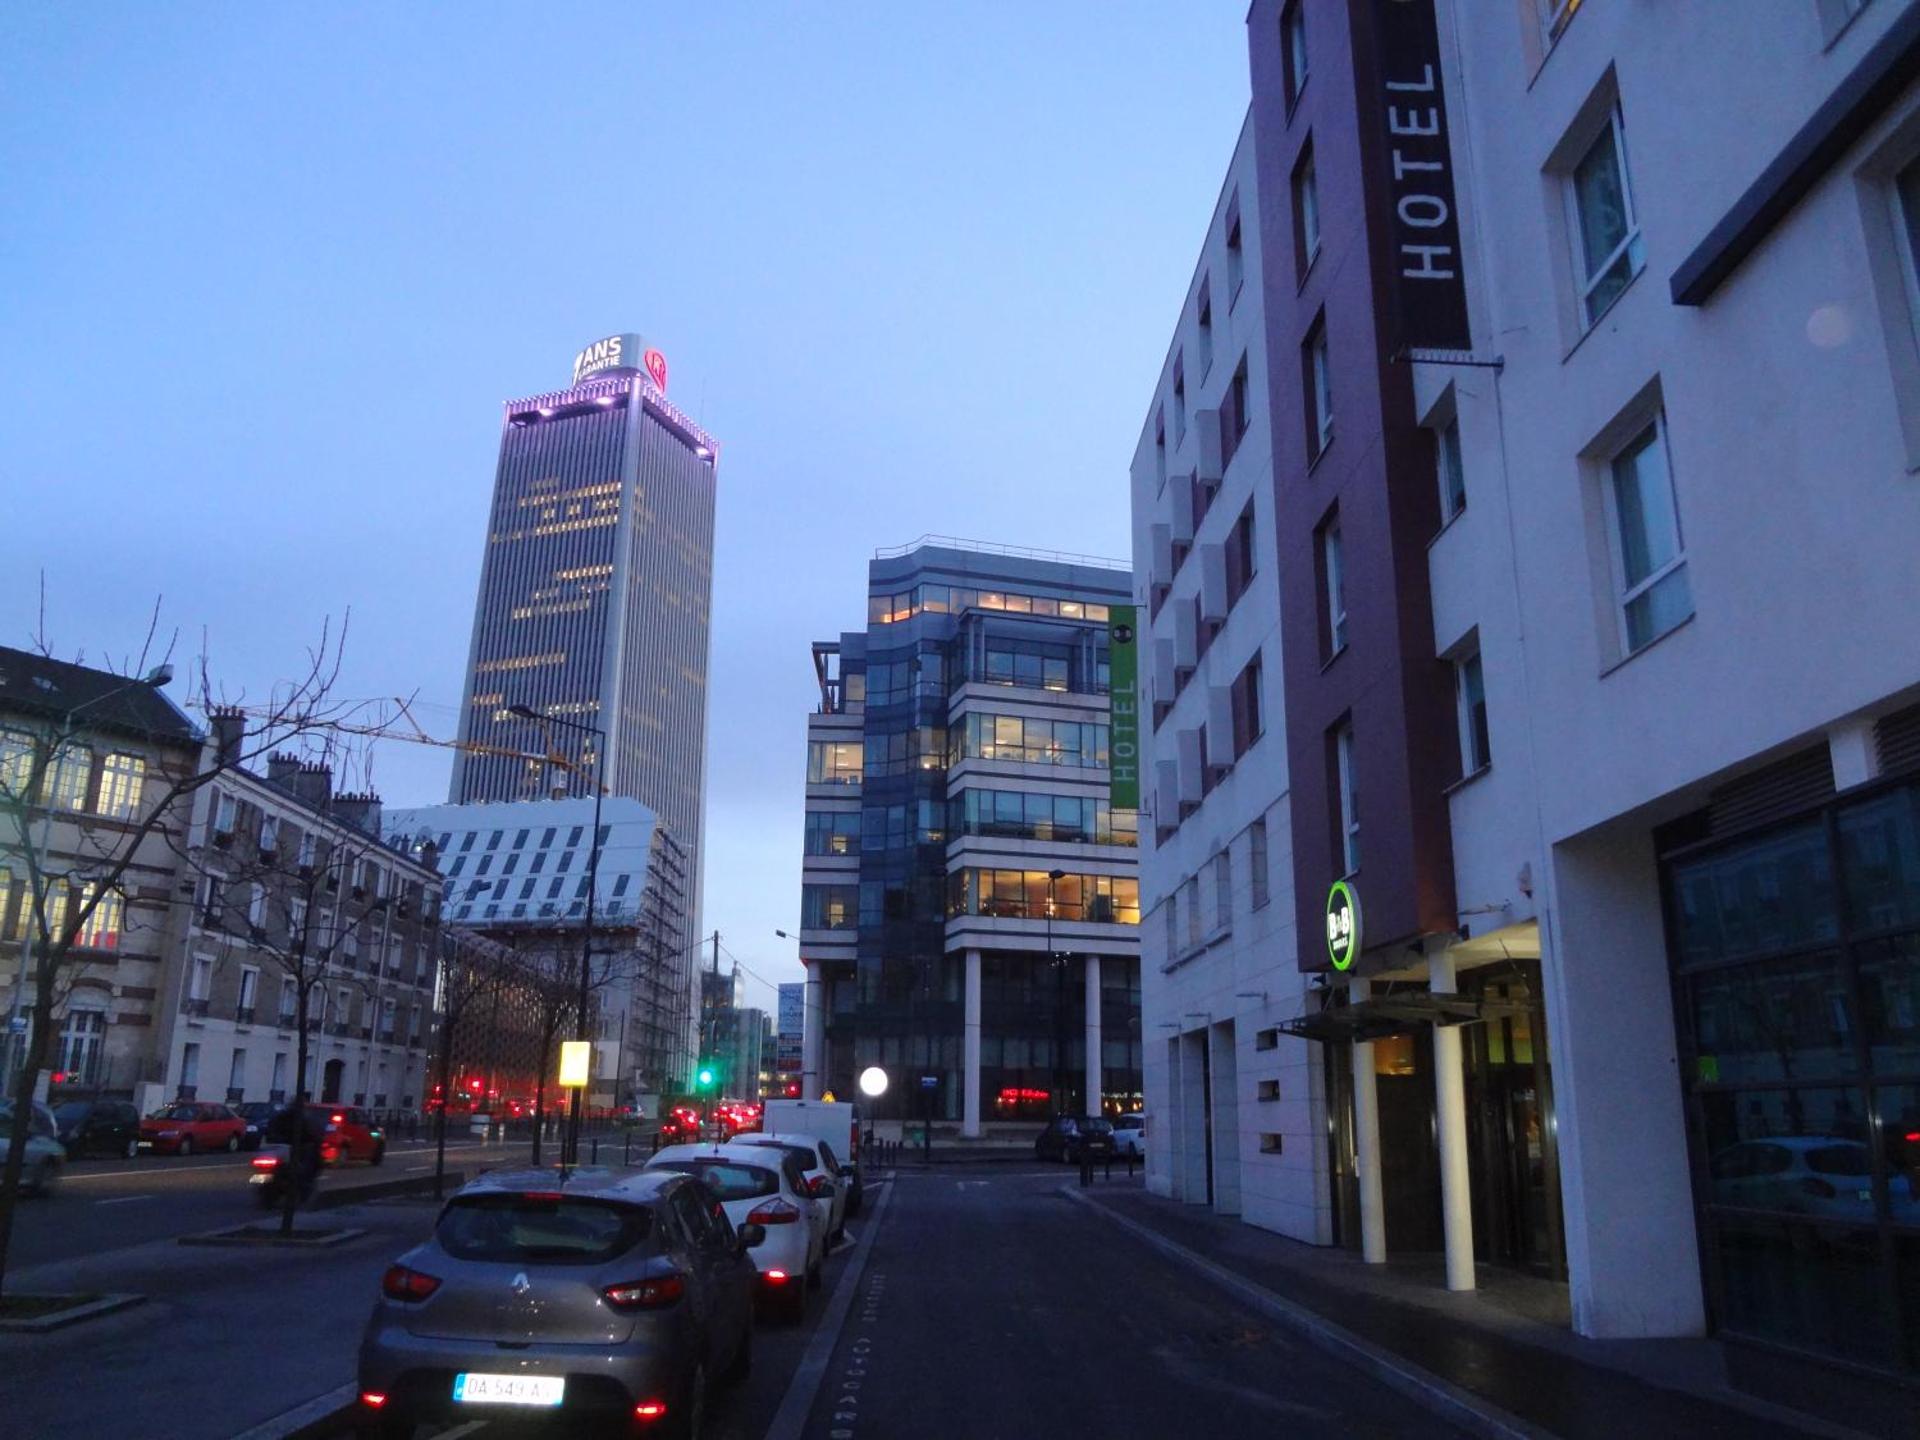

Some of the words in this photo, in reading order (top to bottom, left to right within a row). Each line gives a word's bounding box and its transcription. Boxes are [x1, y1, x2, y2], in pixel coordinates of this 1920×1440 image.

[1386, 63, 1454, 279] HOTEL
[583, 336, 621, 366] ANS
[1113, 680, 1135, 782] HOTEL
